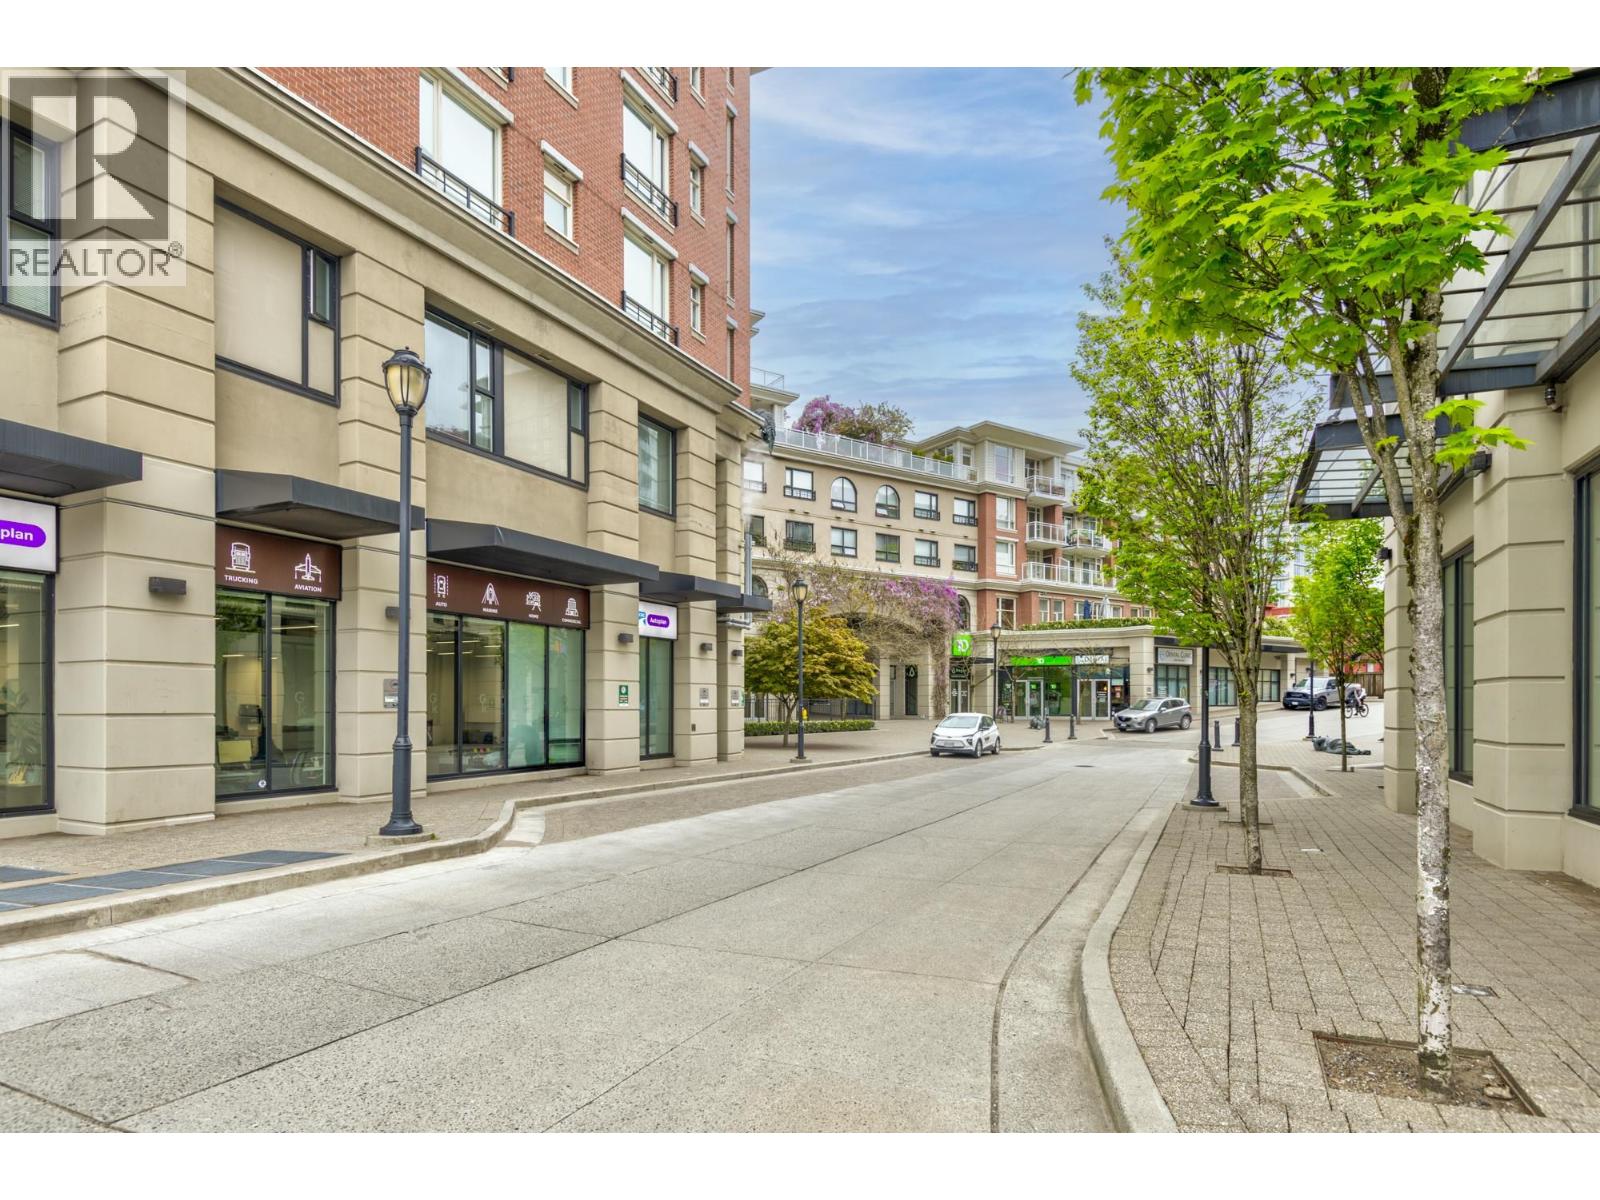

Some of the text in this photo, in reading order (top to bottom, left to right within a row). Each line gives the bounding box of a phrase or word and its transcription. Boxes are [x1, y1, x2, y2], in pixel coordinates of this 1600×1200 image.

[1, 528, 34, 541] plan
[224, 574, 258, 585] TRUCKING
[294, 584, 322, 593] AVIATION
